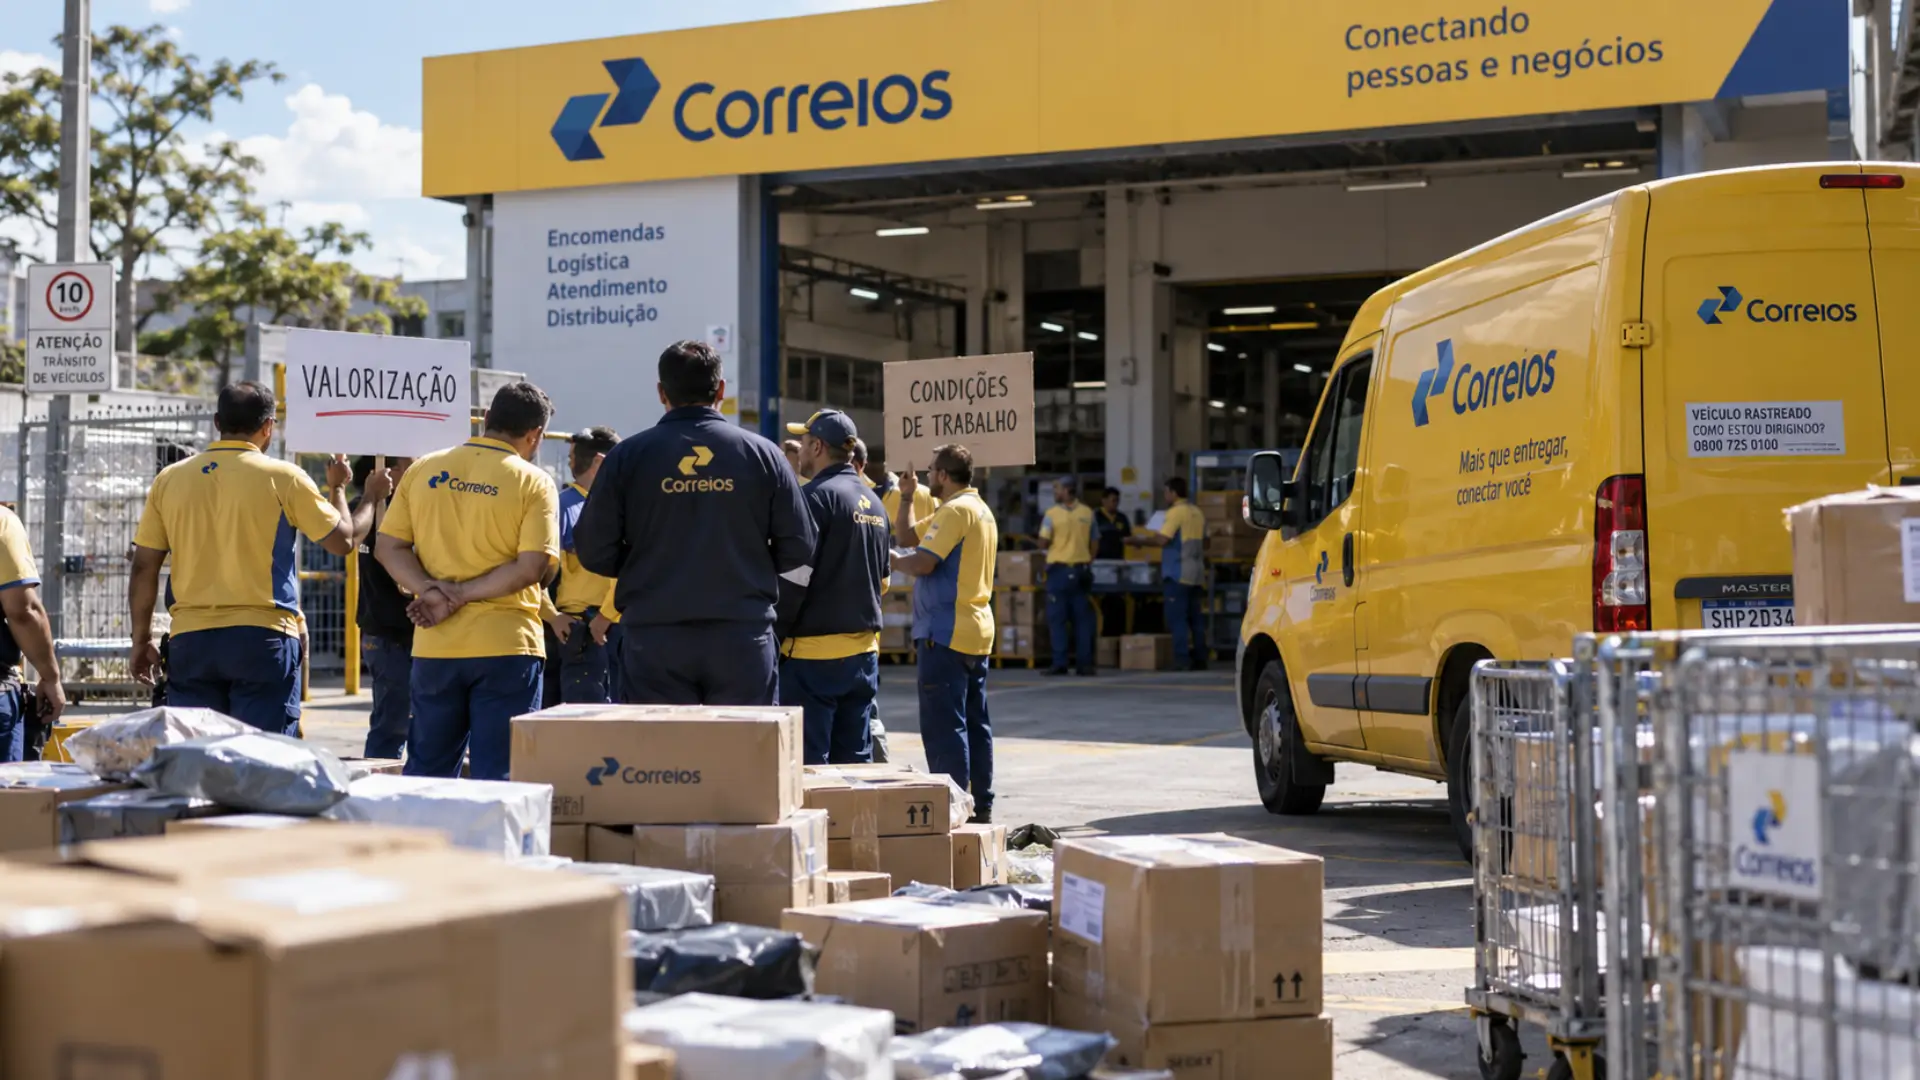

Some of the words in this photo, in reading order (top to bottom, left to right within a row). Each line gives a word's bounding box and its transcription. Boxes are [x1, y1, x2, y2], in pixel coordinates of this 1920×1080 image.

[1345, 6, 1530, 51] Conectando
[1347, 59, 1469, 98] pessoas
[1481, 56, 1499, 77] e
[1511, 36, 1664, 78] negócios
[673, 69, 953, 142] Correios
[548, 222, 665, 248] Encomendas
[548, 252, 630, 277] Logística
[56, 281, 83, 303] 10
[547, 277, 667, 300] Atendimento
[547, 303, 658, 327] Distribuição
[1747, 299, 1857, 323] Correios
[36, 333, 103, 352] ATENÇÃO
[42, 353, 96, 367] TRÂNSITO
[33, 373, 47, 384] DE
[51, 370, 105, 383] VEÍCULOS
[302, 365, 457, 407] VALORIZAÇÃO
[910, 371, 1008, 405] CONDIÇÕES
[1453, 349, 1557, 415] Correios
[902, 416, 923, 439] DE
[932, 409, 1017, 436] TRABALHO
[1692, 406, 1741, 420] VEÍCULO
[1744, 407, 1812, 420] RASTREADO
[1693, 425, 1724, 436] COMO
[1728, 424, 1761, 435] ESTOU
[1765, 423, 1825, 435] DIRIGINDO?
[1459, 448, 1485, 475] Mais
[1489, 447, 1510, 474] que
[1514, 435, 1569, 464] entregar,
[1694, 440, 1723, 452] 0800
[1727, 439, 1748, 451] 725
[1751, 438, 1779, 450] 0100
[449, 478, 499, 496] Correios
[661, 477, 735, 493] Correios
[1457, 480, 1502, 506] conectar
[1506, 471, 1532, 497] você
[1722, 583, 1791, 593] MASTER
[1711, 608, 1795, 628] SHP2D34
[622, 766, 701, 784] Correios
